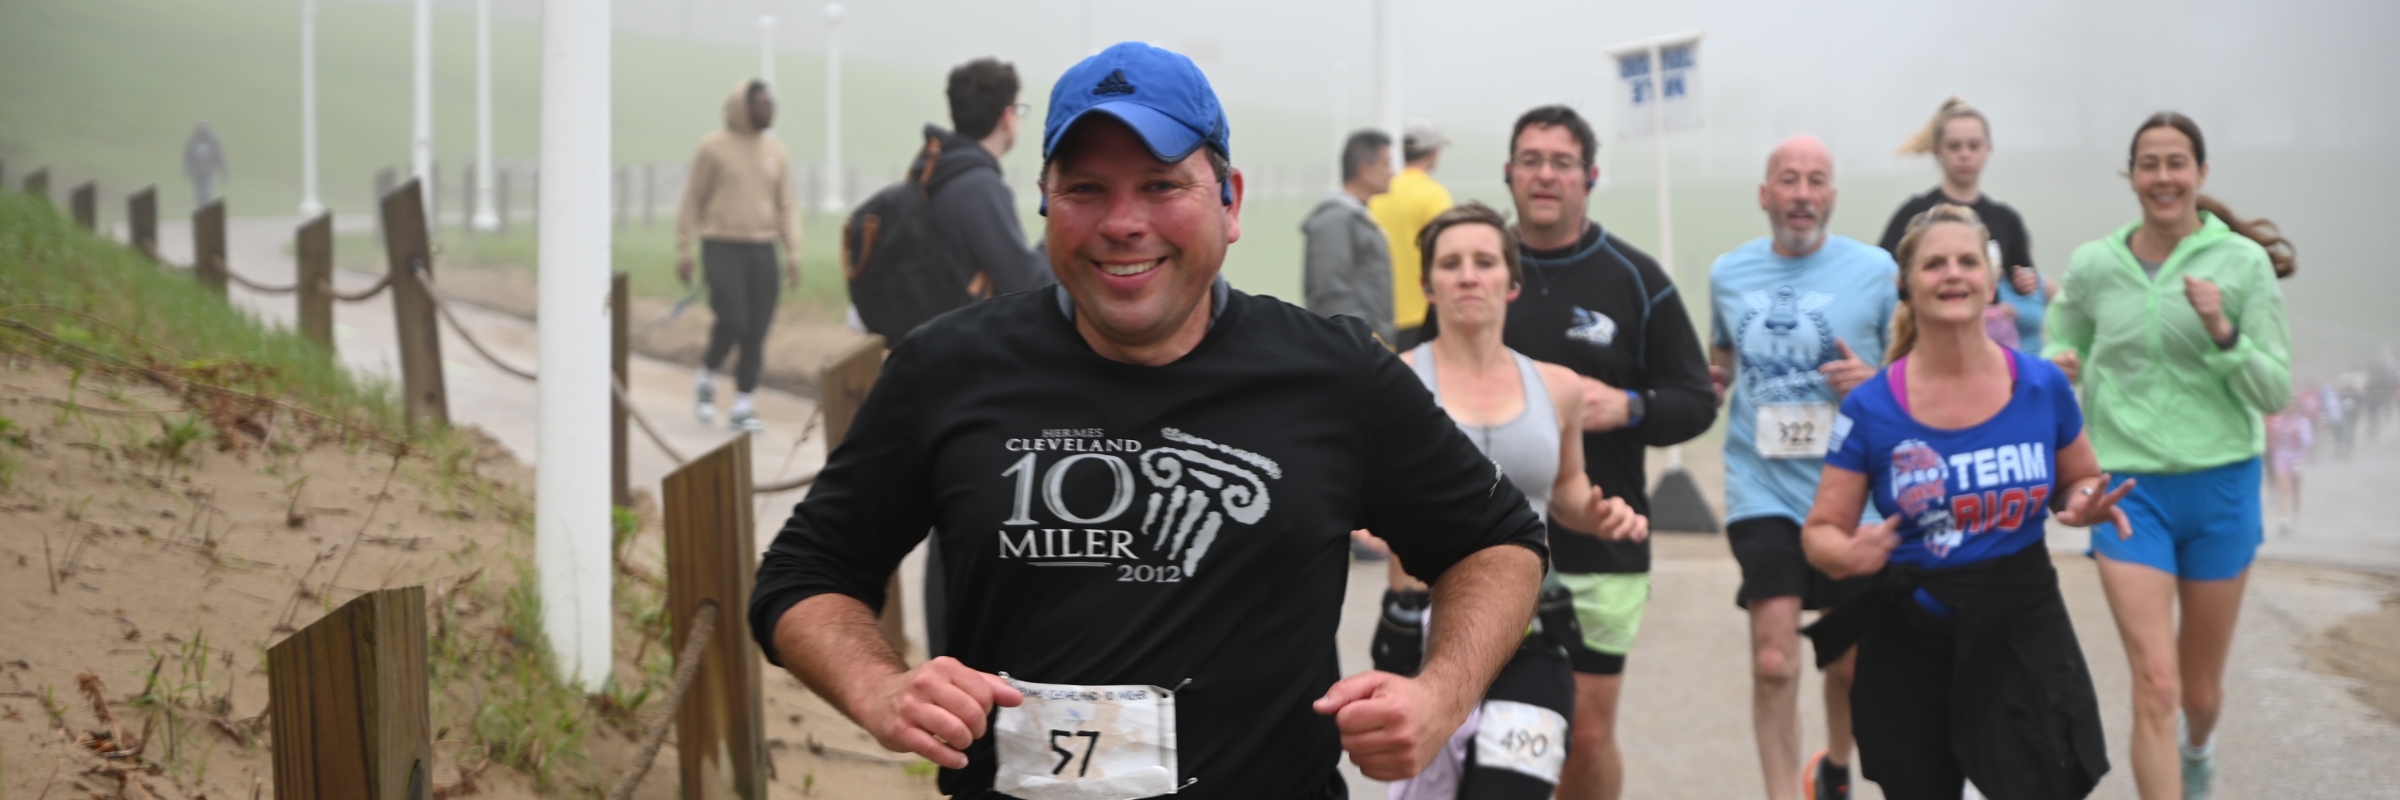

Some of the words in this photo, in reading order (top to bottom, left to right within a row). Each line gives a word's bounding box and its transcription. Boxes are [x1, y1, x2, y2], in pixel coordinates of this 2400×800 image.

[1005, 438, 1142, 452] CLEVELAND
[1042, 428, 1104, 438] HERMES
[1949, 441, 2048, 491] TEAM
[1000, 452, 1136, 525] 10
[1952, 483, 2049, 534] RIOT
[998, 528, 1139, 560] MILER
[1116, 564, 1182, 583] 2012
[1049, 729, 1101, 777] 57
[1500, 728, 1548, 758] 490
